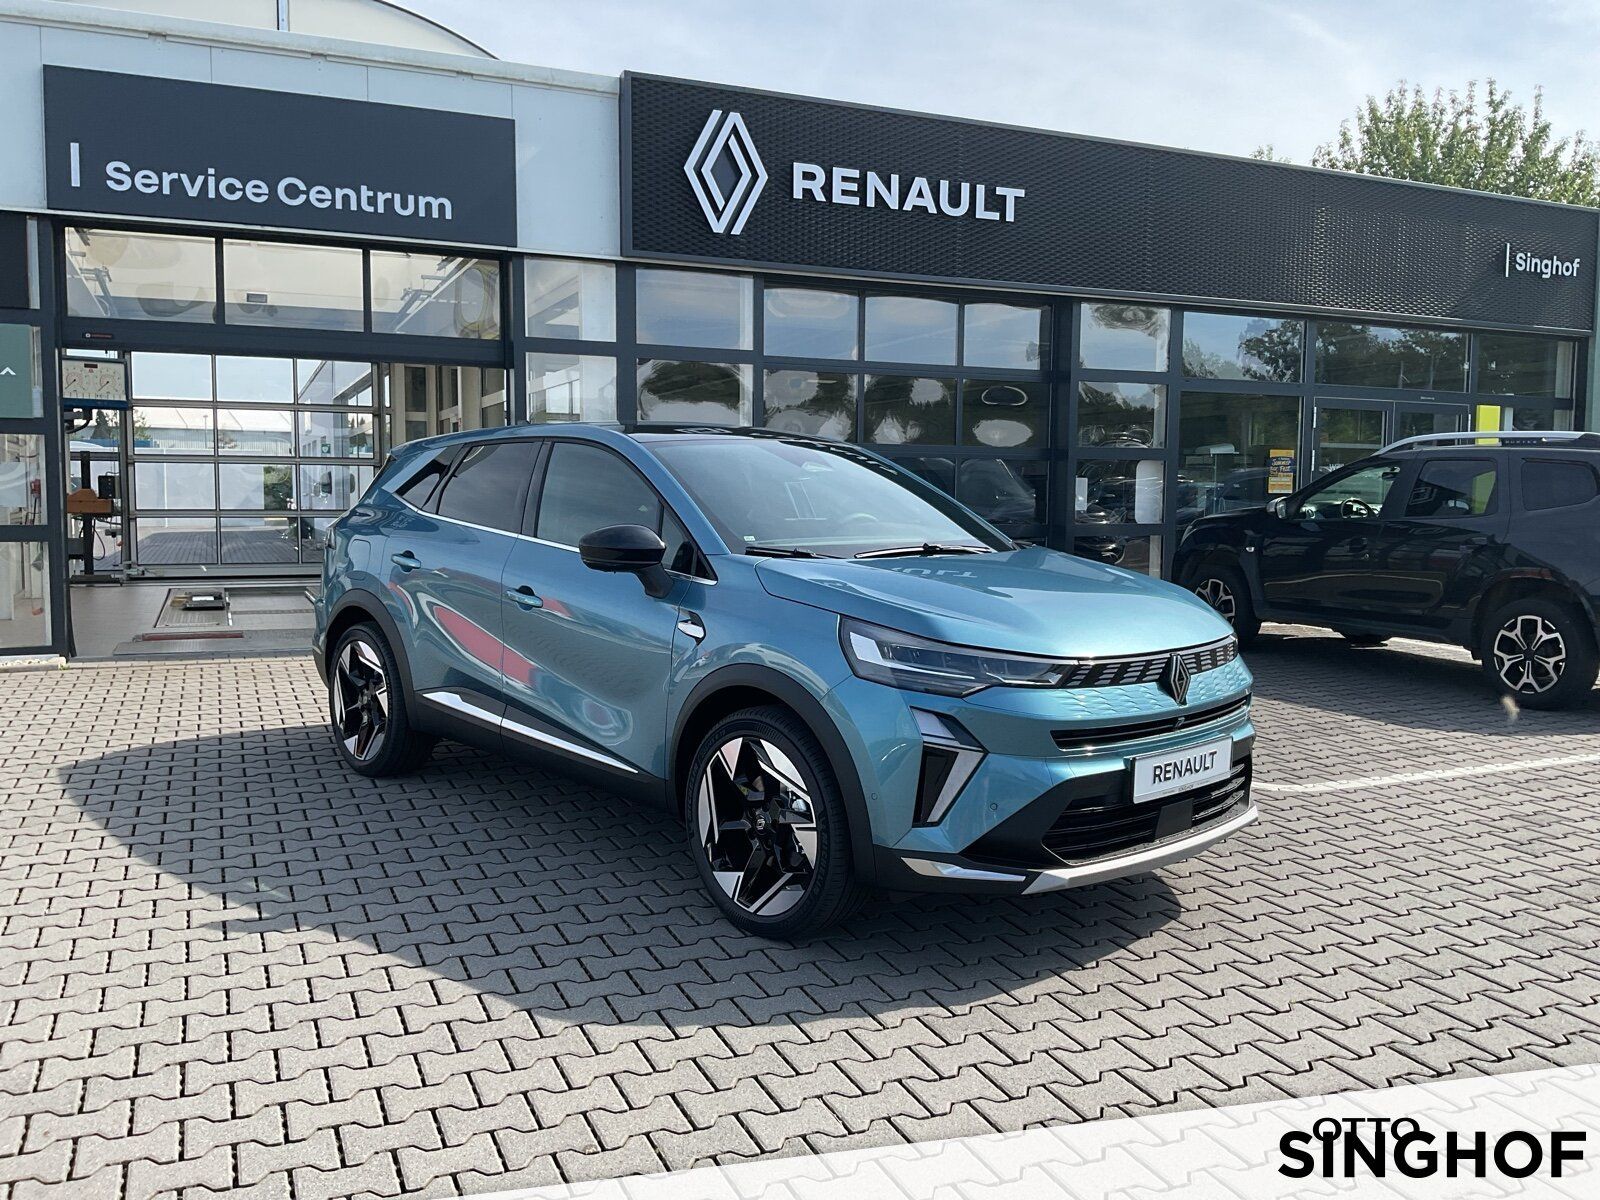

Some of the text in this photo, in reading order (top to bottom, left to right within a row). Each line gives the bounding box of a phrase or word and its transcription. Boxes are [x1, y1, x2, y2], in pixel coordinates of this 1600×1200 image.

[105, 160, 453, 220] Service Centrum
[793, 161, 1026, 223] RENAULT
[1515, 252, 1581, 279] Singhof
[1152, 750, 1218, 784] RENAULT
